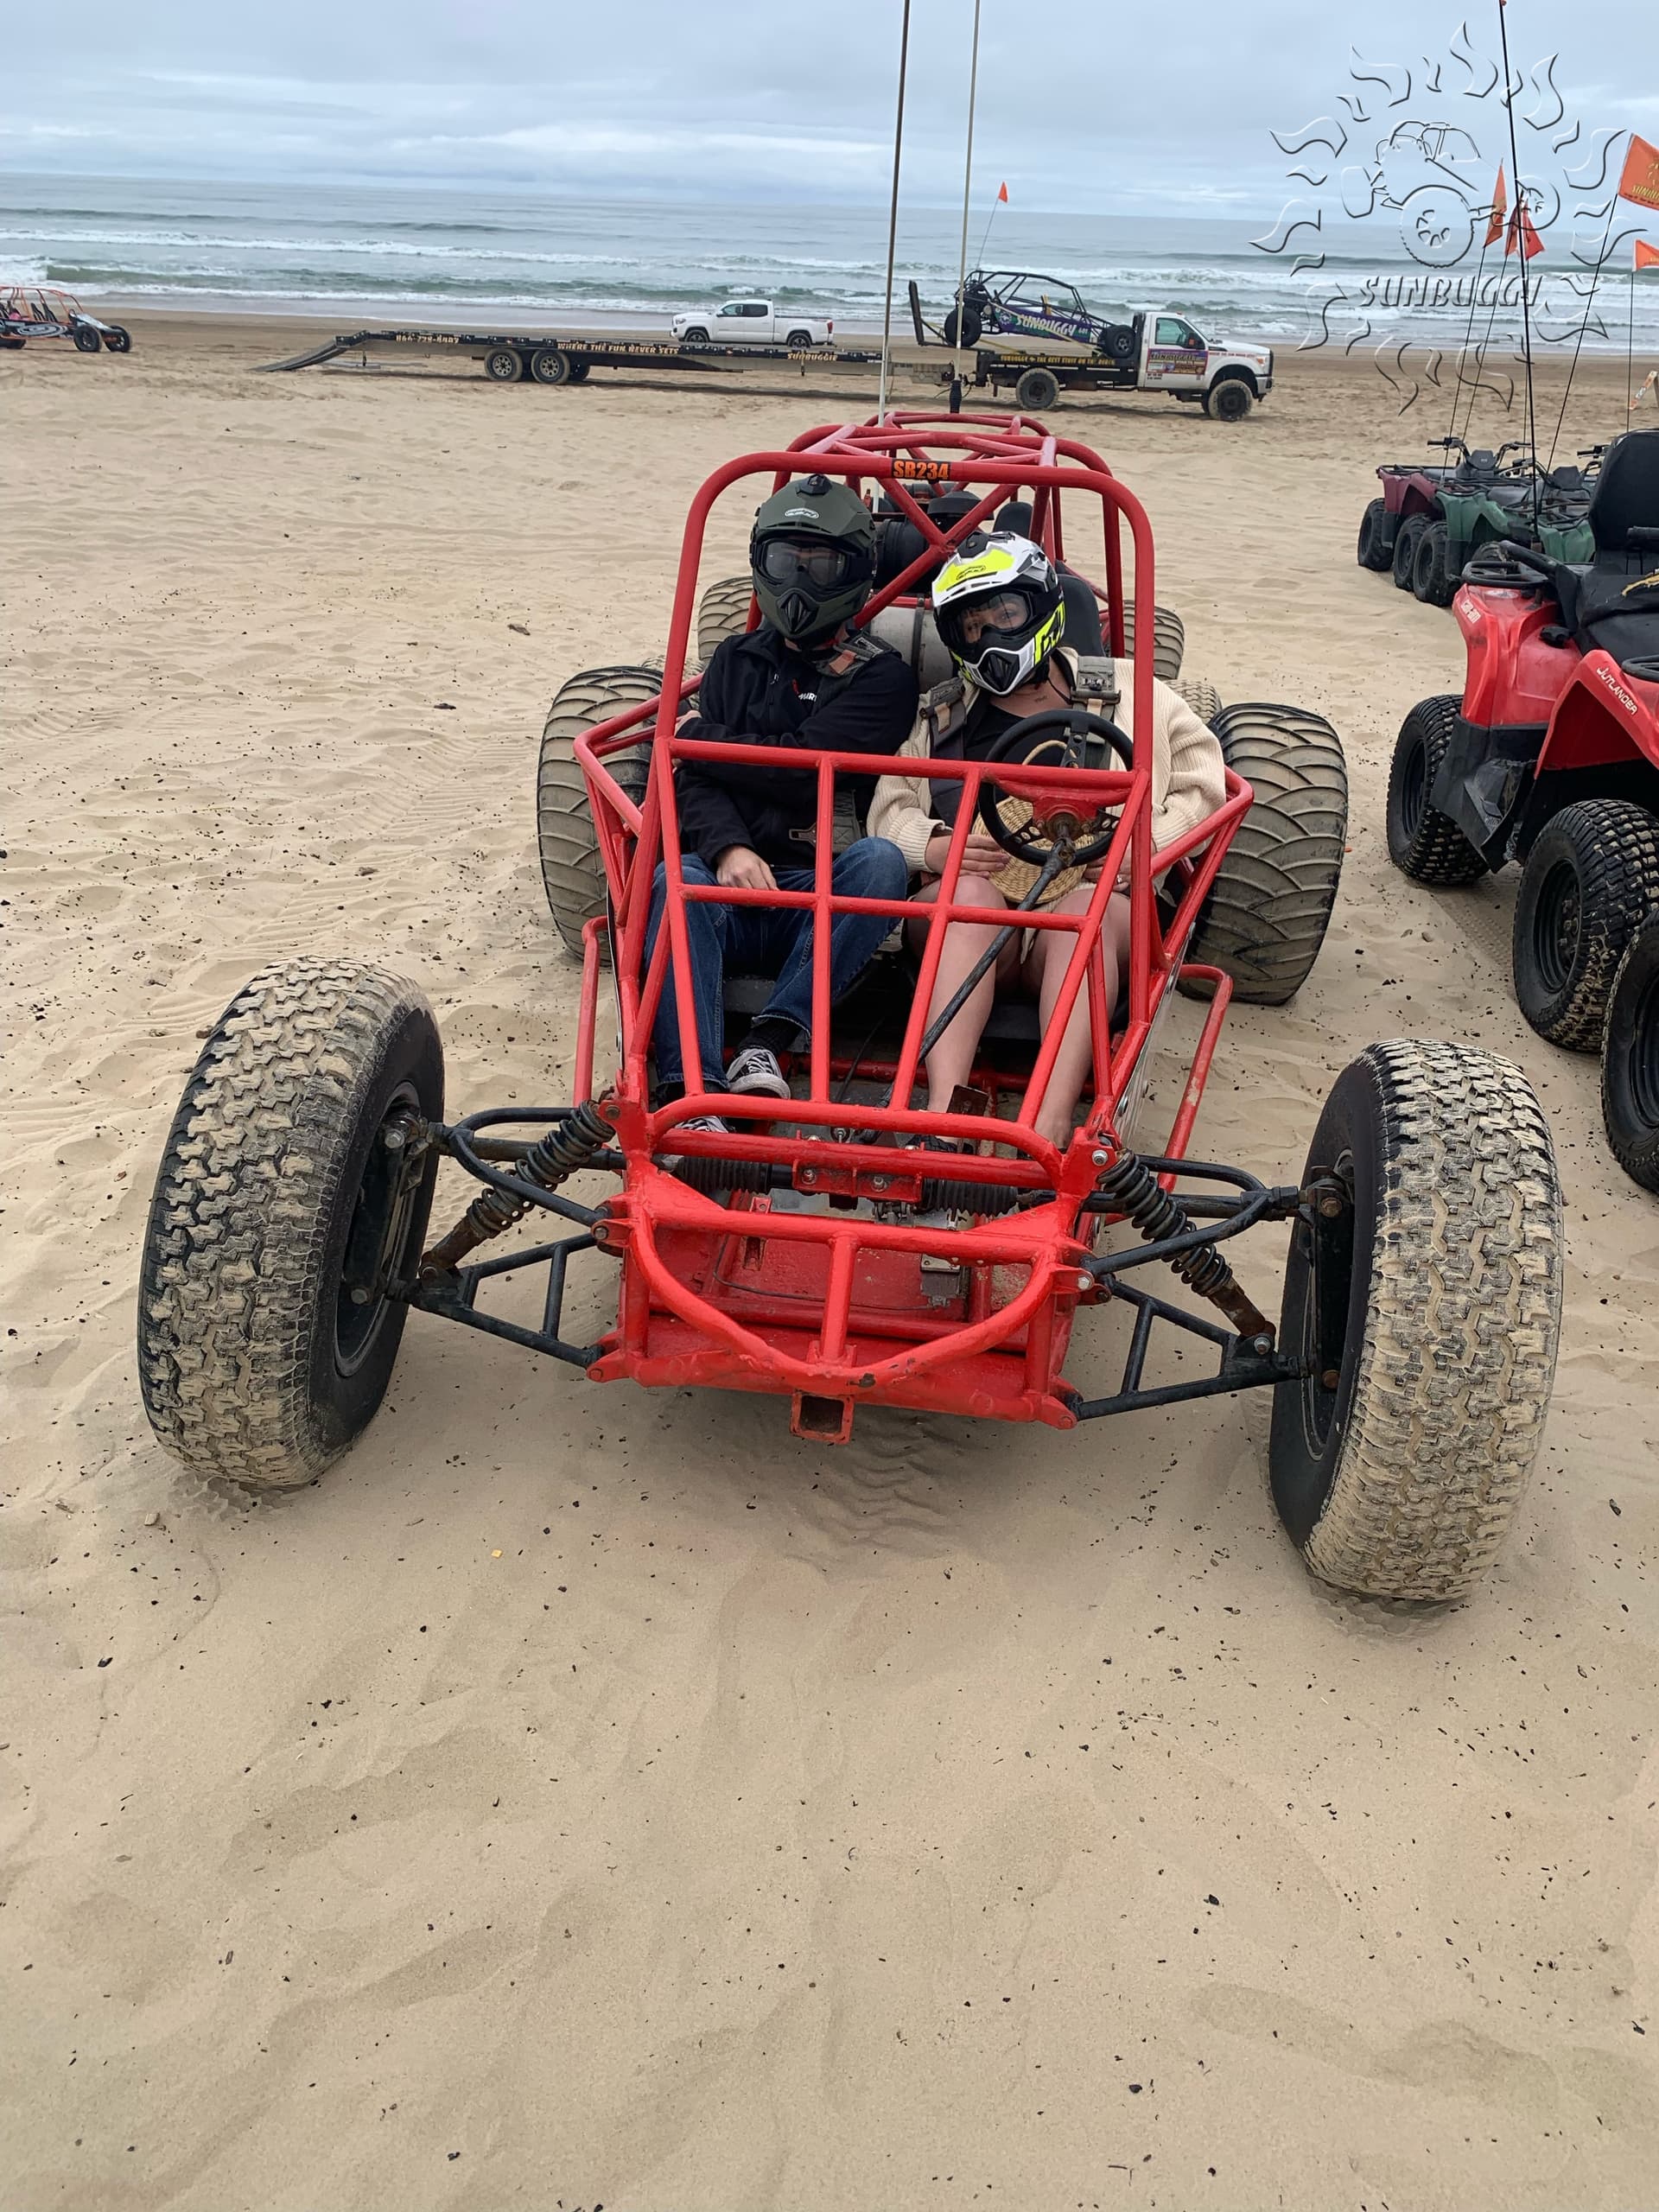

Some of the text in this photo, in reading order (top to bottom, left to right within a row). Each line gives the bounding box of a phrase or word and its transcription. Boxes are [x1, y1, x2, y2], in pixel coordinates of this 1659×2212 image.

[1015, 314, 1077, 336] SUNBUGGY
[590, 342, 606, 352] THE
[659, 346, 679, 354] SETS
[893, 460, 949, 480] SB234
